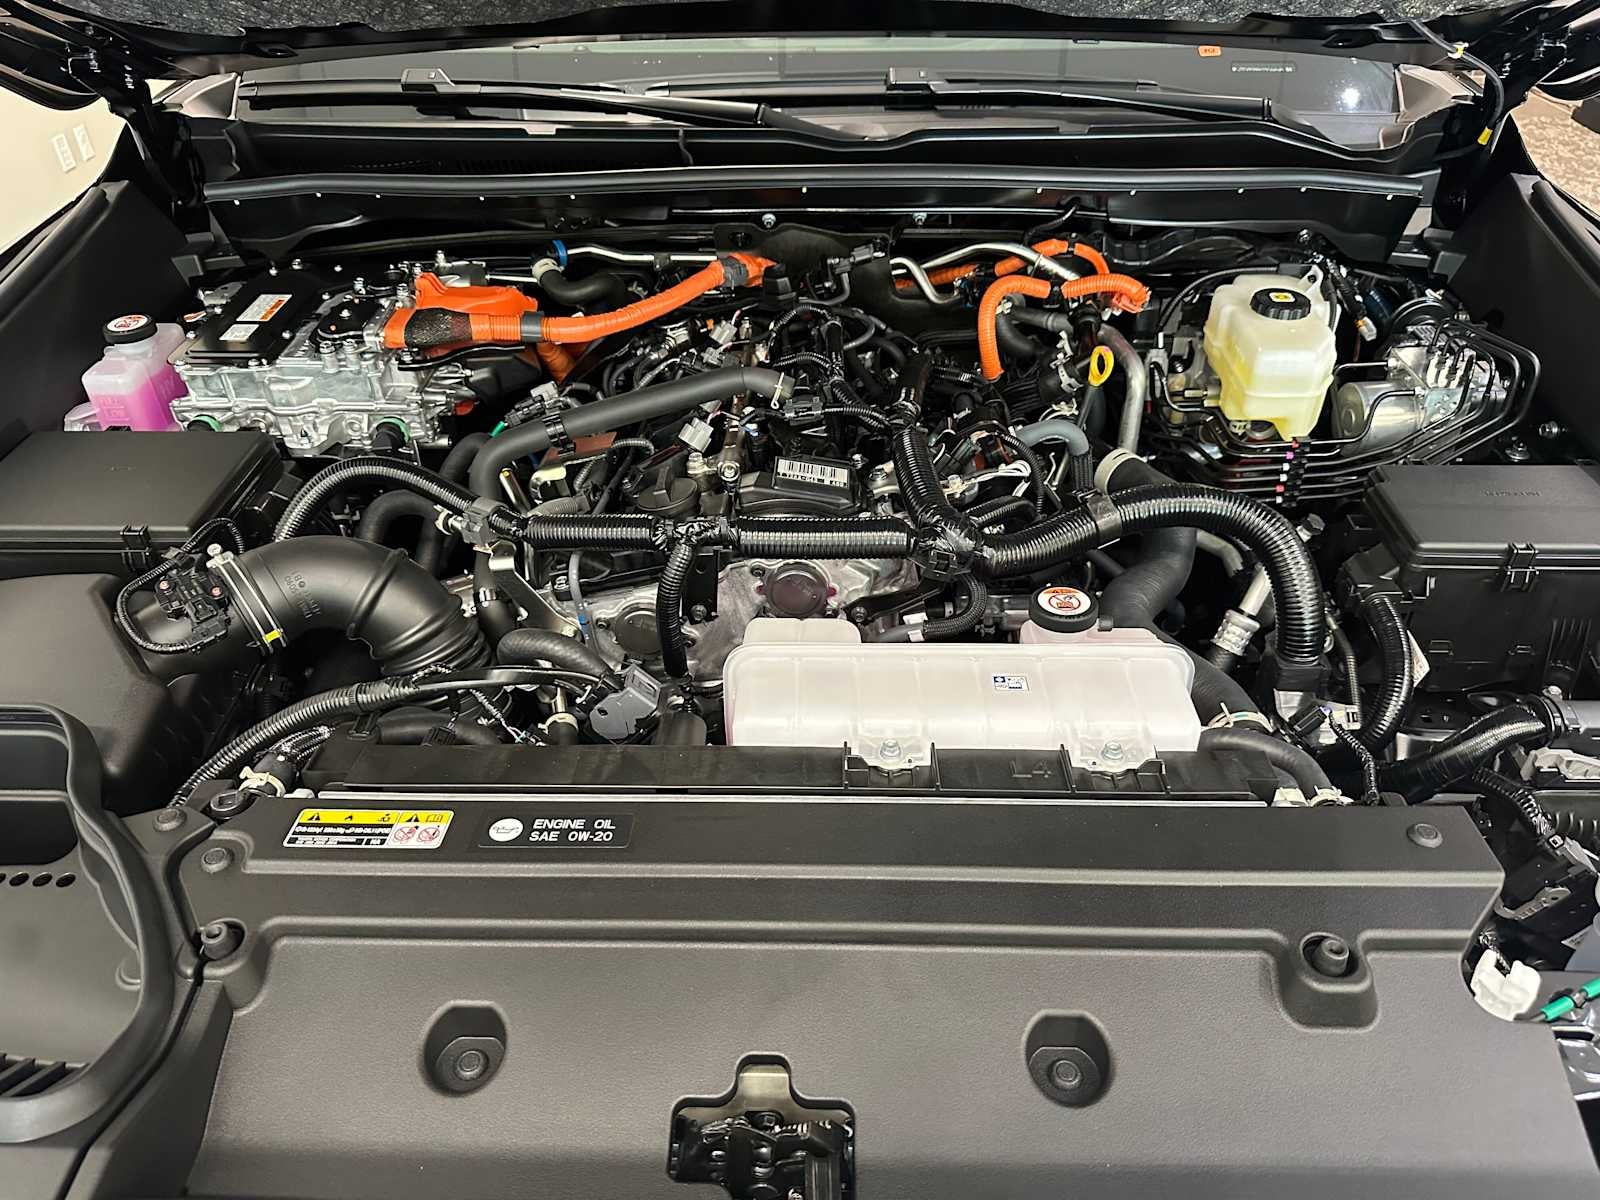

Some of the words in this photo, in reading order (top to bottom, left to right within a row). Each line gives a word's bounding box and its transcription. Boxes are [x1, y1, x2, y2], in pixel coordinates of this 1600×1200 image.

[532, 818, 586, 830] ENGINE
[593, 818, 616, 830] OIL
[528, 830, 560, 842] SAE
[567, 830, 614, 842] 0W-20
